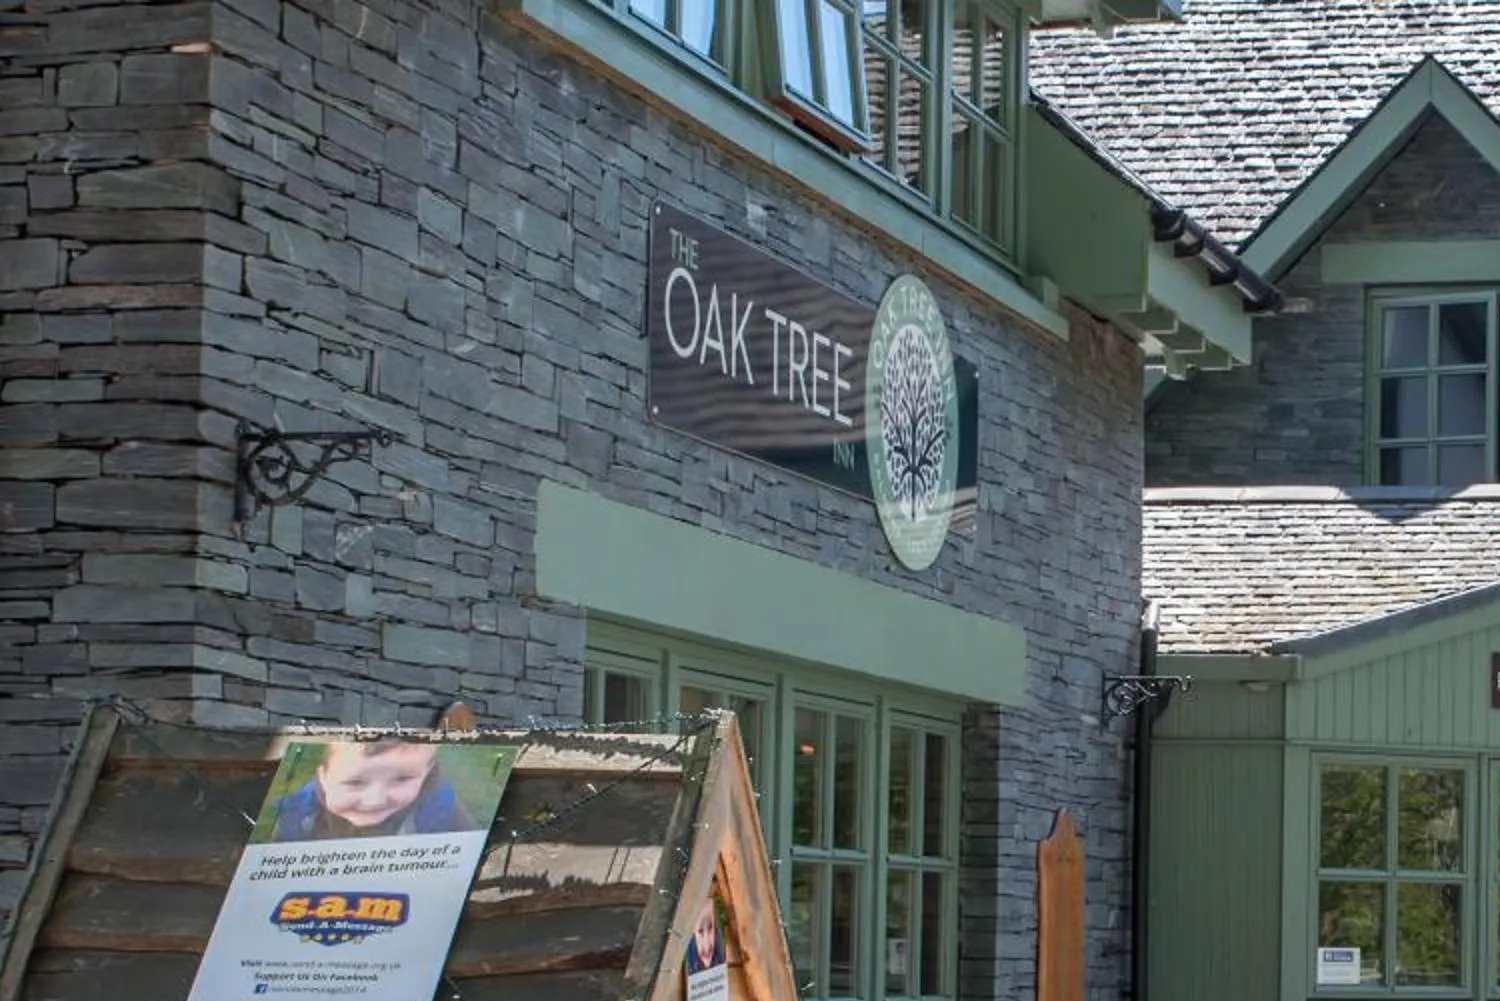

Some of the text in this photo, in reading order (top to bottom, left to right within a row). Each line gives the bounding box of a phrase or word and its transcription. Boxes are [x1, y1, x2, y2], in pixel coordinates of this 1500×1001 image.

[669, 227, 699, 270] THE
[665, 267, 853, 427] OAK TREE
[833, 438, 855, 472] INN
[249, 868, 287, 881] child
[291, 865, 326, 878] with
[329, 868, 339, 876] a
[342, 862, 385, 875] brain
[261, 844, 461, 867] Help brighten the day of a
